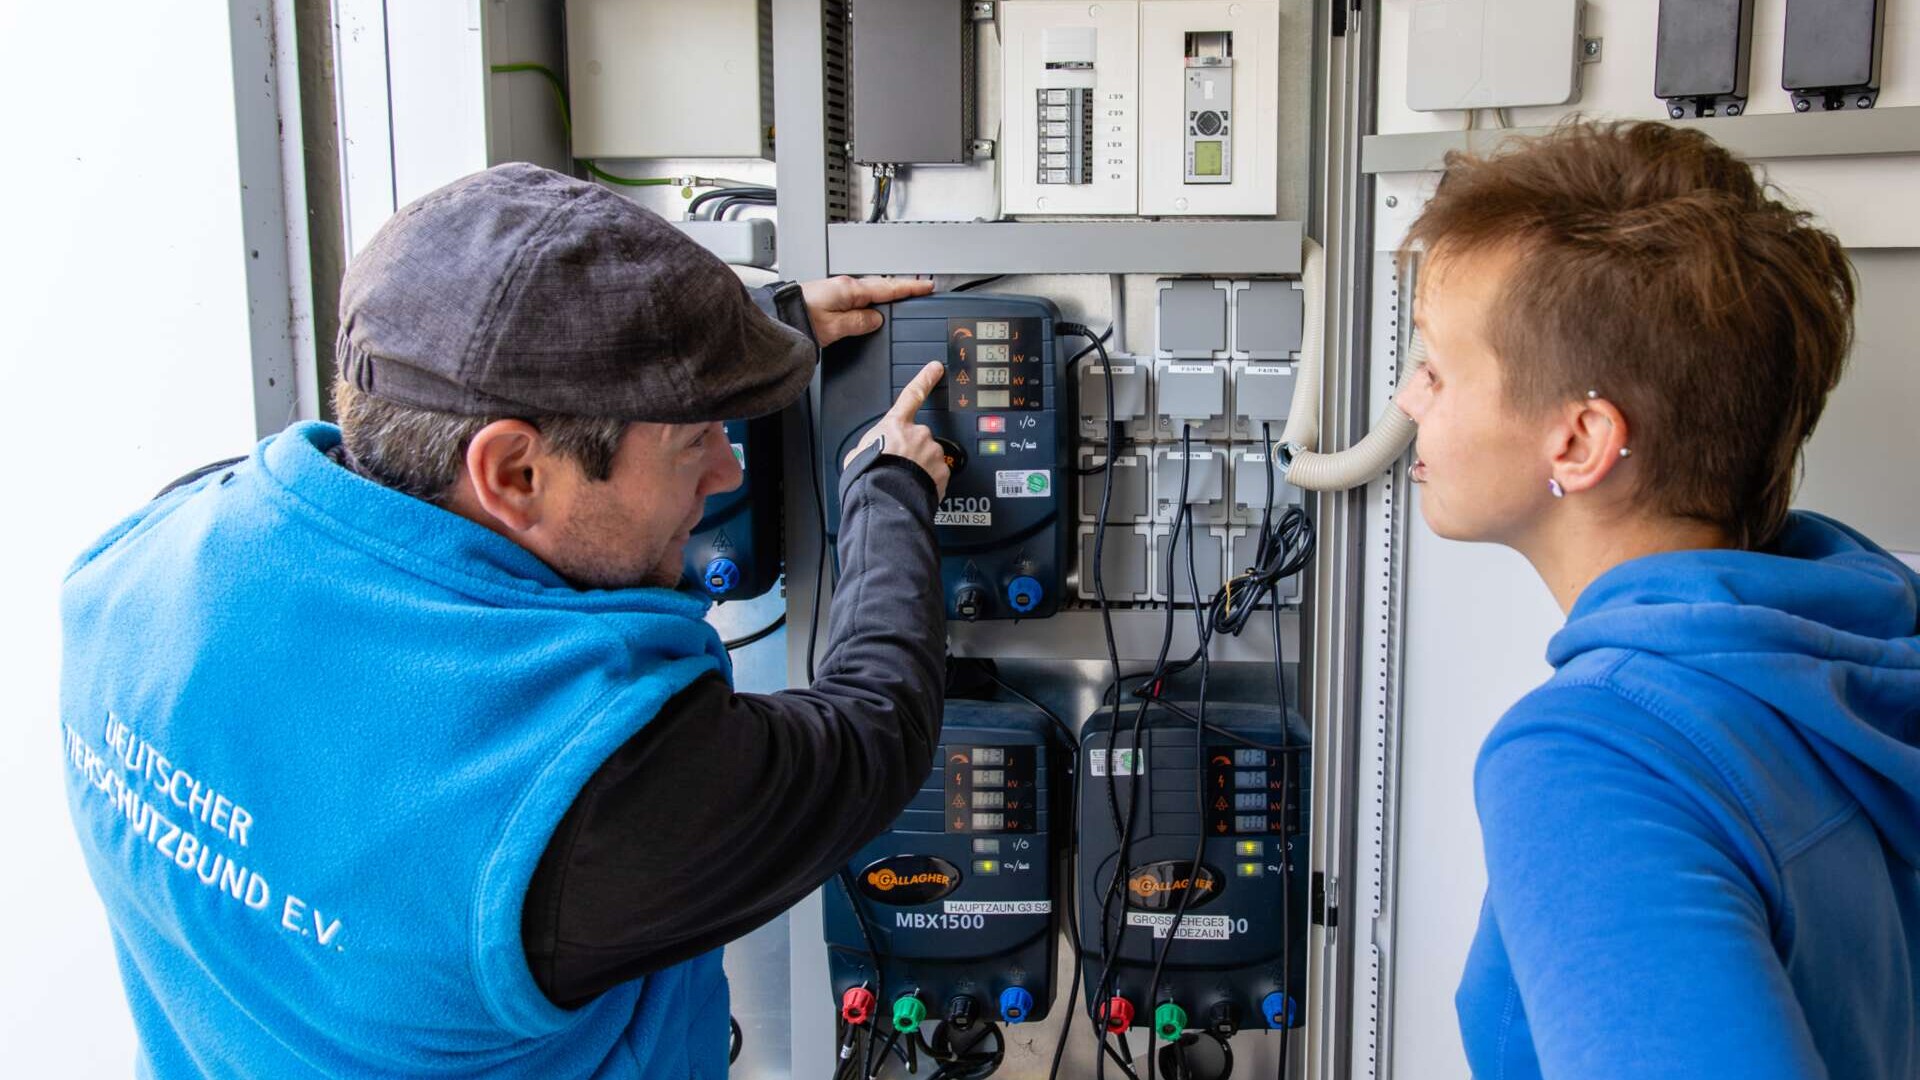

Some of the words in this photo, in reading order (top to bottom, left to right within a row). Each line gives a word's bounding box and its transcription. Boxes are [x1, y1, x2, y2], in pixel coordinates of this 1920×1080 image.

[1012, 354, 1024, 363] kV
[1013, 377, 1024, 385] kV
[1013, 398, 1025, 406] kV
[938, 496, 991, 512] 1500
[972, 514, 986, 524] S2
[104, 710, 254, 848] DEUTSCHER
[64, 724, 270, 910] TIERSCHUTZBUND
[281, 895, 344, 952] E.V.
[880, 874, 950, 887] GALLAGHER
[950, 903, 1015, 912] HAUPTZAUN
[1018, 903, 1032, 912] G3
[1035, 903, 1048, 912] S2
[896, 912, 984, 929] MBX1500
[1160, 928, 1224, 938] WIDEZAUN
